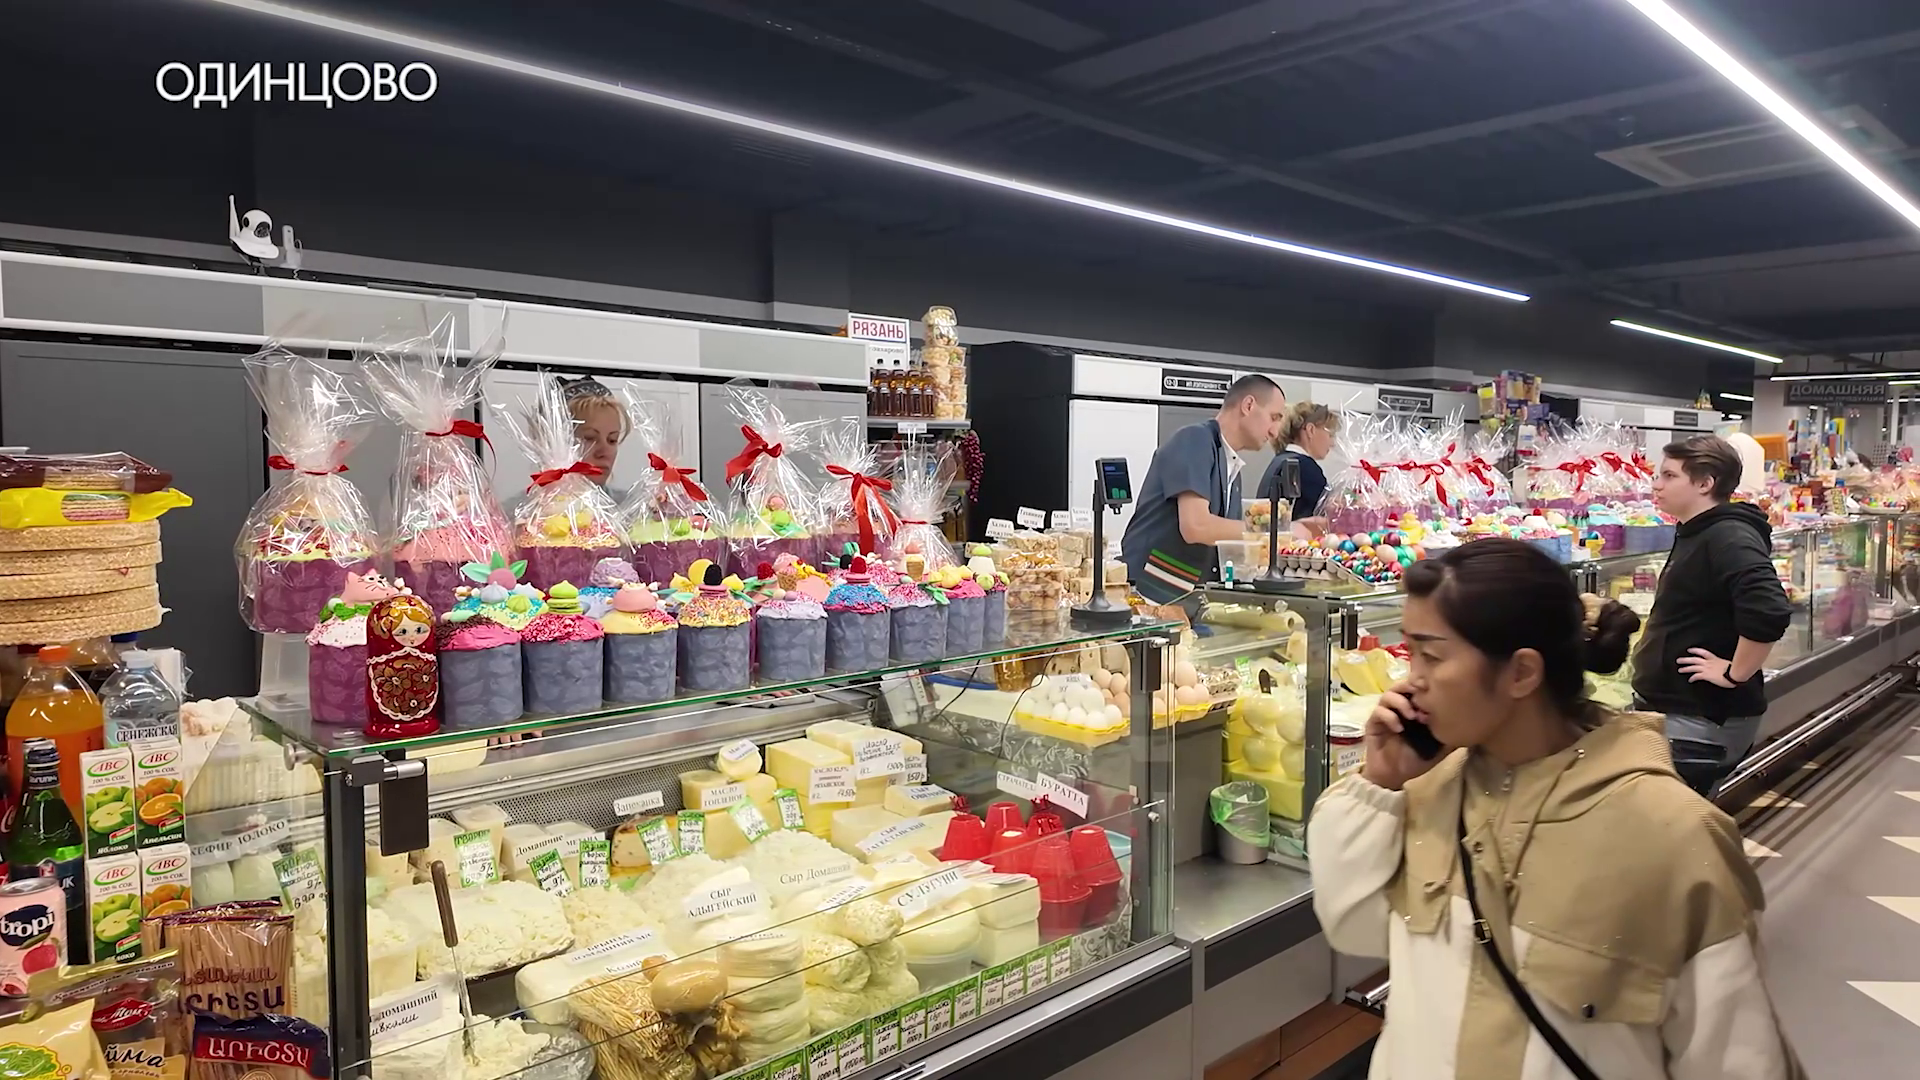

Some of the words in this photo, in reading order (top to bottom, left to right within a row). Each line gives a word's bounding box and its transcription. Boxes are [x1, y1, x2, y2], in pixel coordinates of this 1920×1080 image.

[853, 320, 904, 339] РЯЗАНЬ
[1789, 384, 1885, 395] ДОМАШНЯЯ
[116, 724, 178, 742] СЕНЕЖСКАЯ
[161, 766, 176, 774] СОК
[111, 774, 126, 782] СОК
[711, 786, 738, 797] МАСЛО
[1040, 777, 1084, 806] БУРАТТА
[142, 833, 182, 845] Апельсин
[515, 834, 564, 858] Домашние
[97, 844, 129, 854] Яблоко
[169, 872, 185, 880] СОК
[780, 873, 804, 885] Сыр
[806, 861, 851, 880] Домашний
[709, 888, 732, 900] СЫР
[897, 871, 959, 907] СУЛУГУНИ
[688, 892, 757, 918] АДЫГЕЙСКИЙ
[104, 1043, 166, 1069] йма
